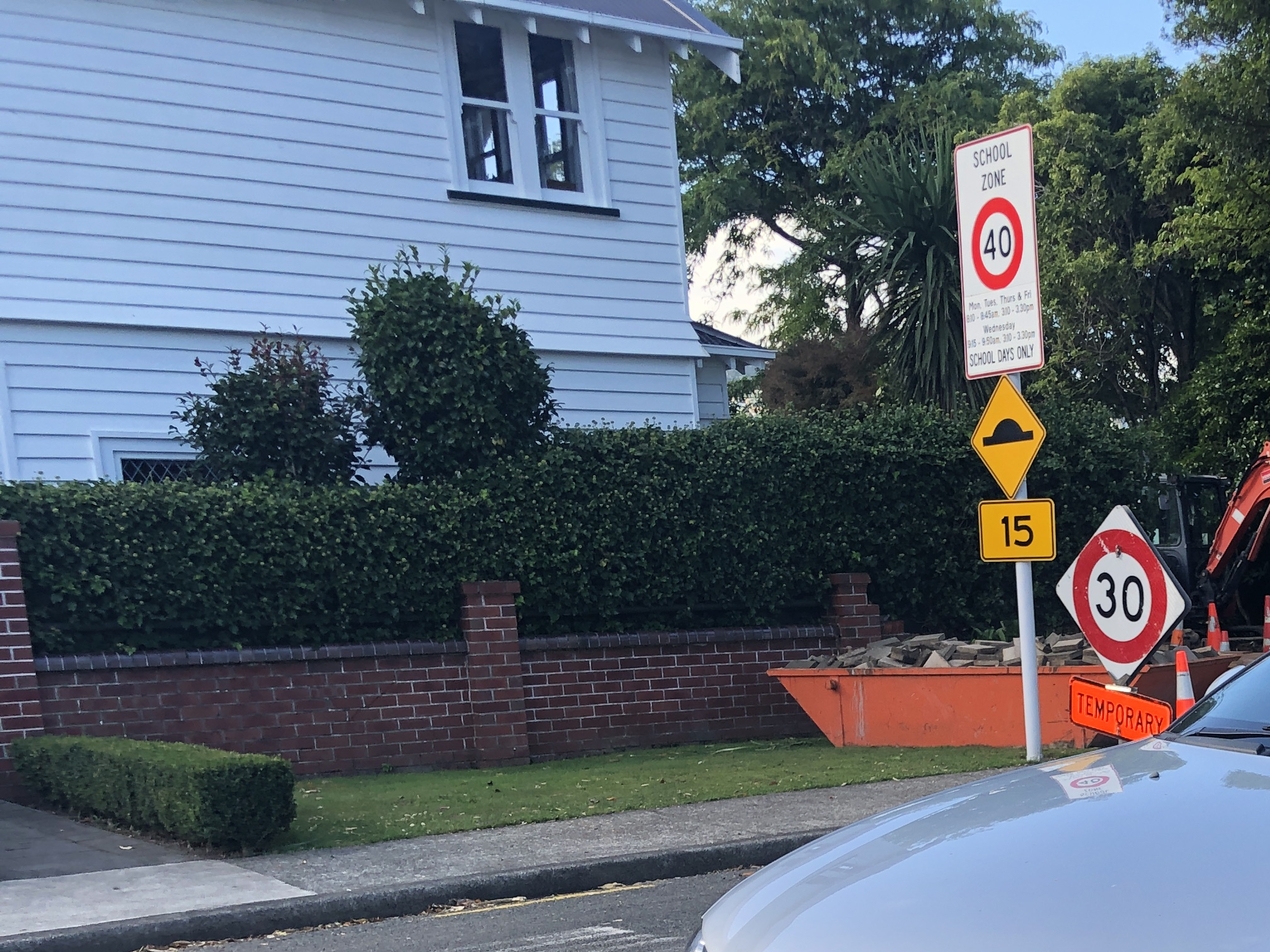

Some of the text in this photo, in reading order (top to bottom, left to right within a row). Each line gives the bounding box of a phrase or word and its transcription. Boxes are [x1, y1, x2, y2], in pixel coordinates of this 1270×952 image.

[973, 141, 1012, 168] SCHOOL
[981, 168, 1007, 191] ZONE
[983, 225, 1012, 260] 40
[1024, 290, 1032, 299] Fri
[983, 321, 1016, 334] Wednesday
[969, 344, 1034, 367] SCHOOL DAYS ONLY
[1001, 515, 1034, 548] 15
[1096, 571, 1145, 623] 30
[1077, 693, 1164, 735] TEMPORARY
